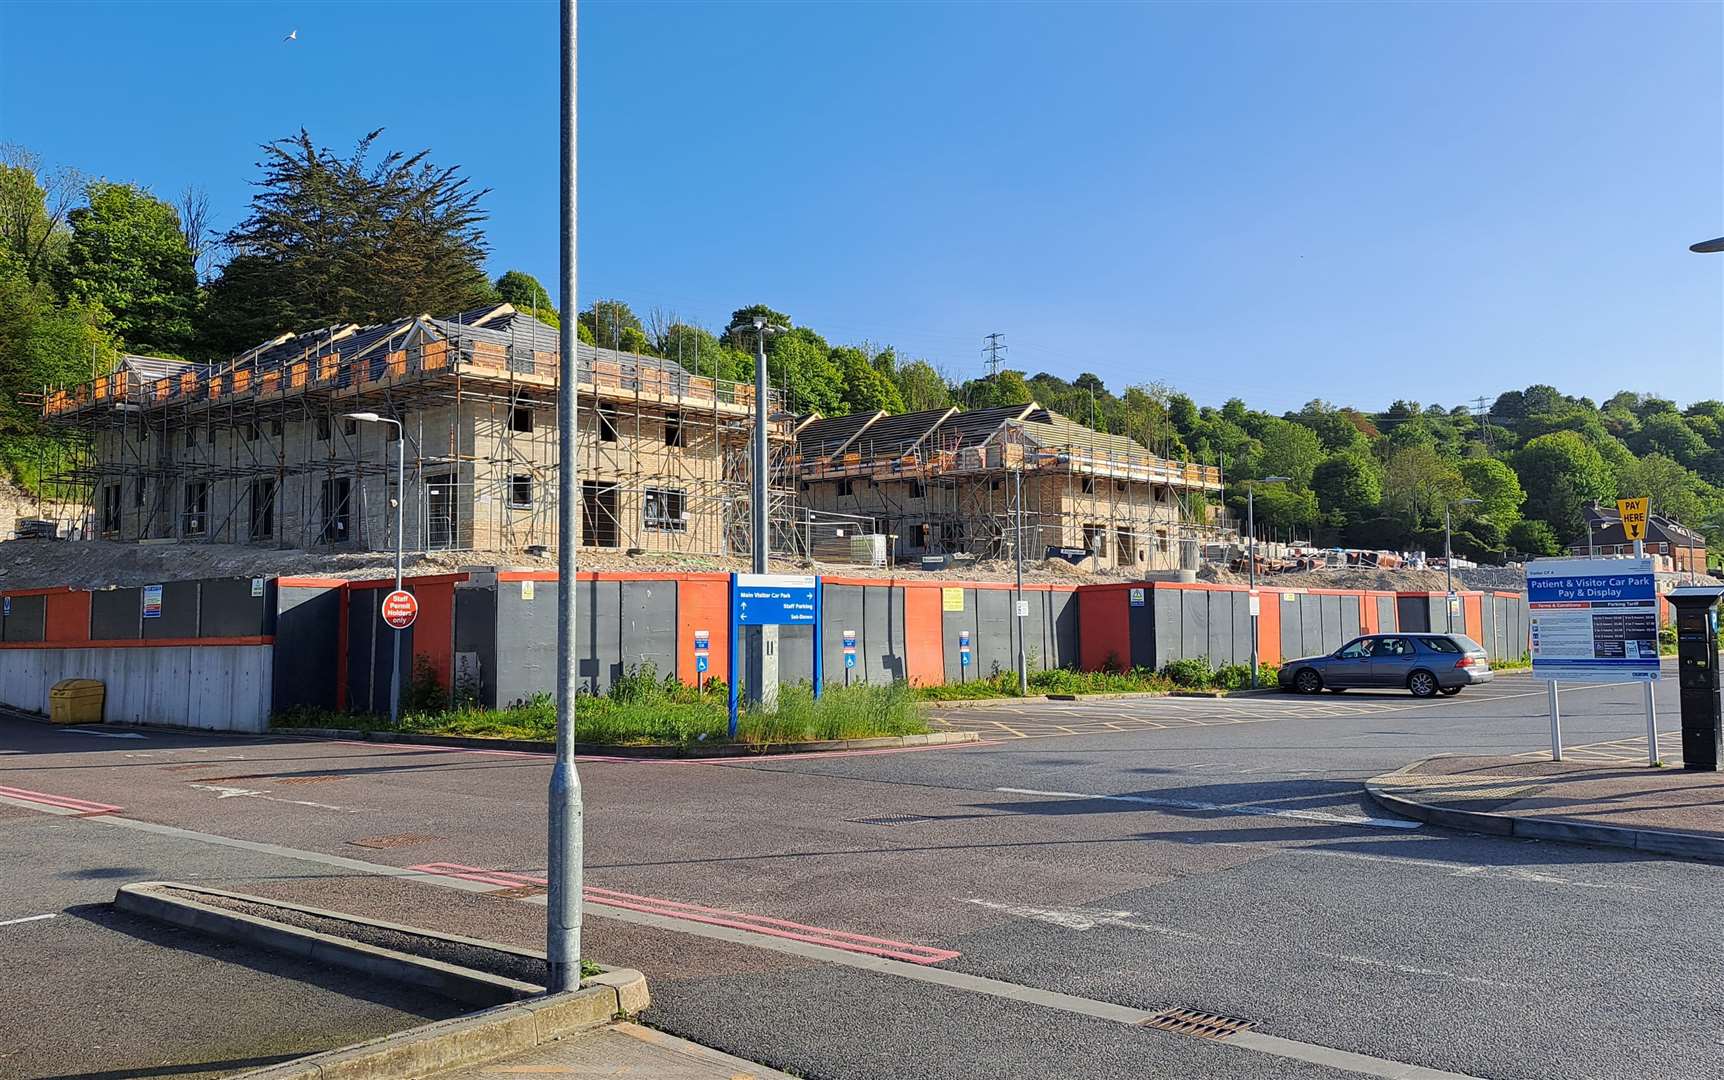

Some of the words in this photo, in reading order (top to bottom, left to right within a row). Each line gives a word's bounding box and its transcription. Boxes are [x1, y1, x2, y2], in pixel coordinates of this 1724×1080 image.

[1626, 501, 1640, 510] PAY
[1624, 513, 1644, 522] HERE
[1531, 580, 1564, 588] Patient
[1576, 578, 1606, 587] Visitor
[1609, 578, 1625, 586] Car
[1628, 577, 1650, 585] Park
[1558, 589, 1575, 599] Pay
[1587, 588, 1622, 598] Display
